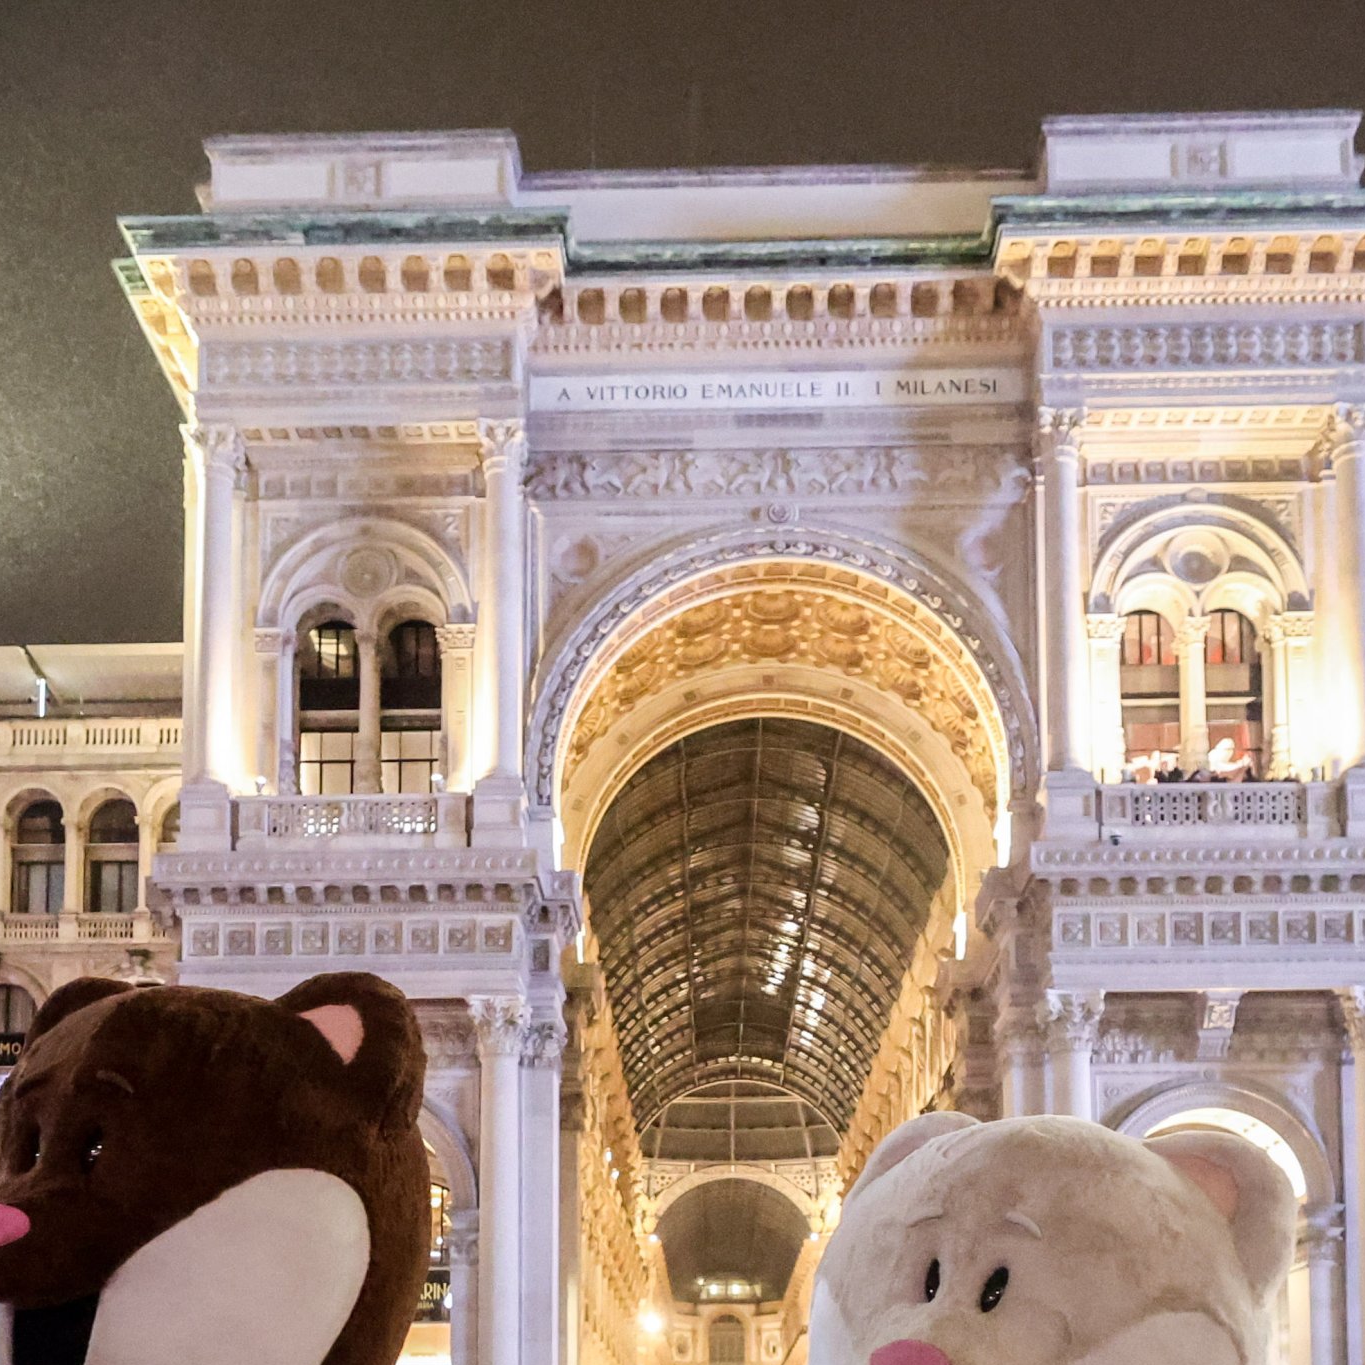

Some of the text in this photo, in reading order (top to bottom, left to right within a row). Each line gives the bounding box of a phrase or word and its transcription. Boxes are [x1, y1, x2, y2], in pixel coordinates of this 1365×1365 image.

[557, 387, 571, 401] A
[586, 384, 687, 401] VITTORIO
[701, 381, 822, 399] EMANUELE
[895, 378, 998, 396] MILANESI
